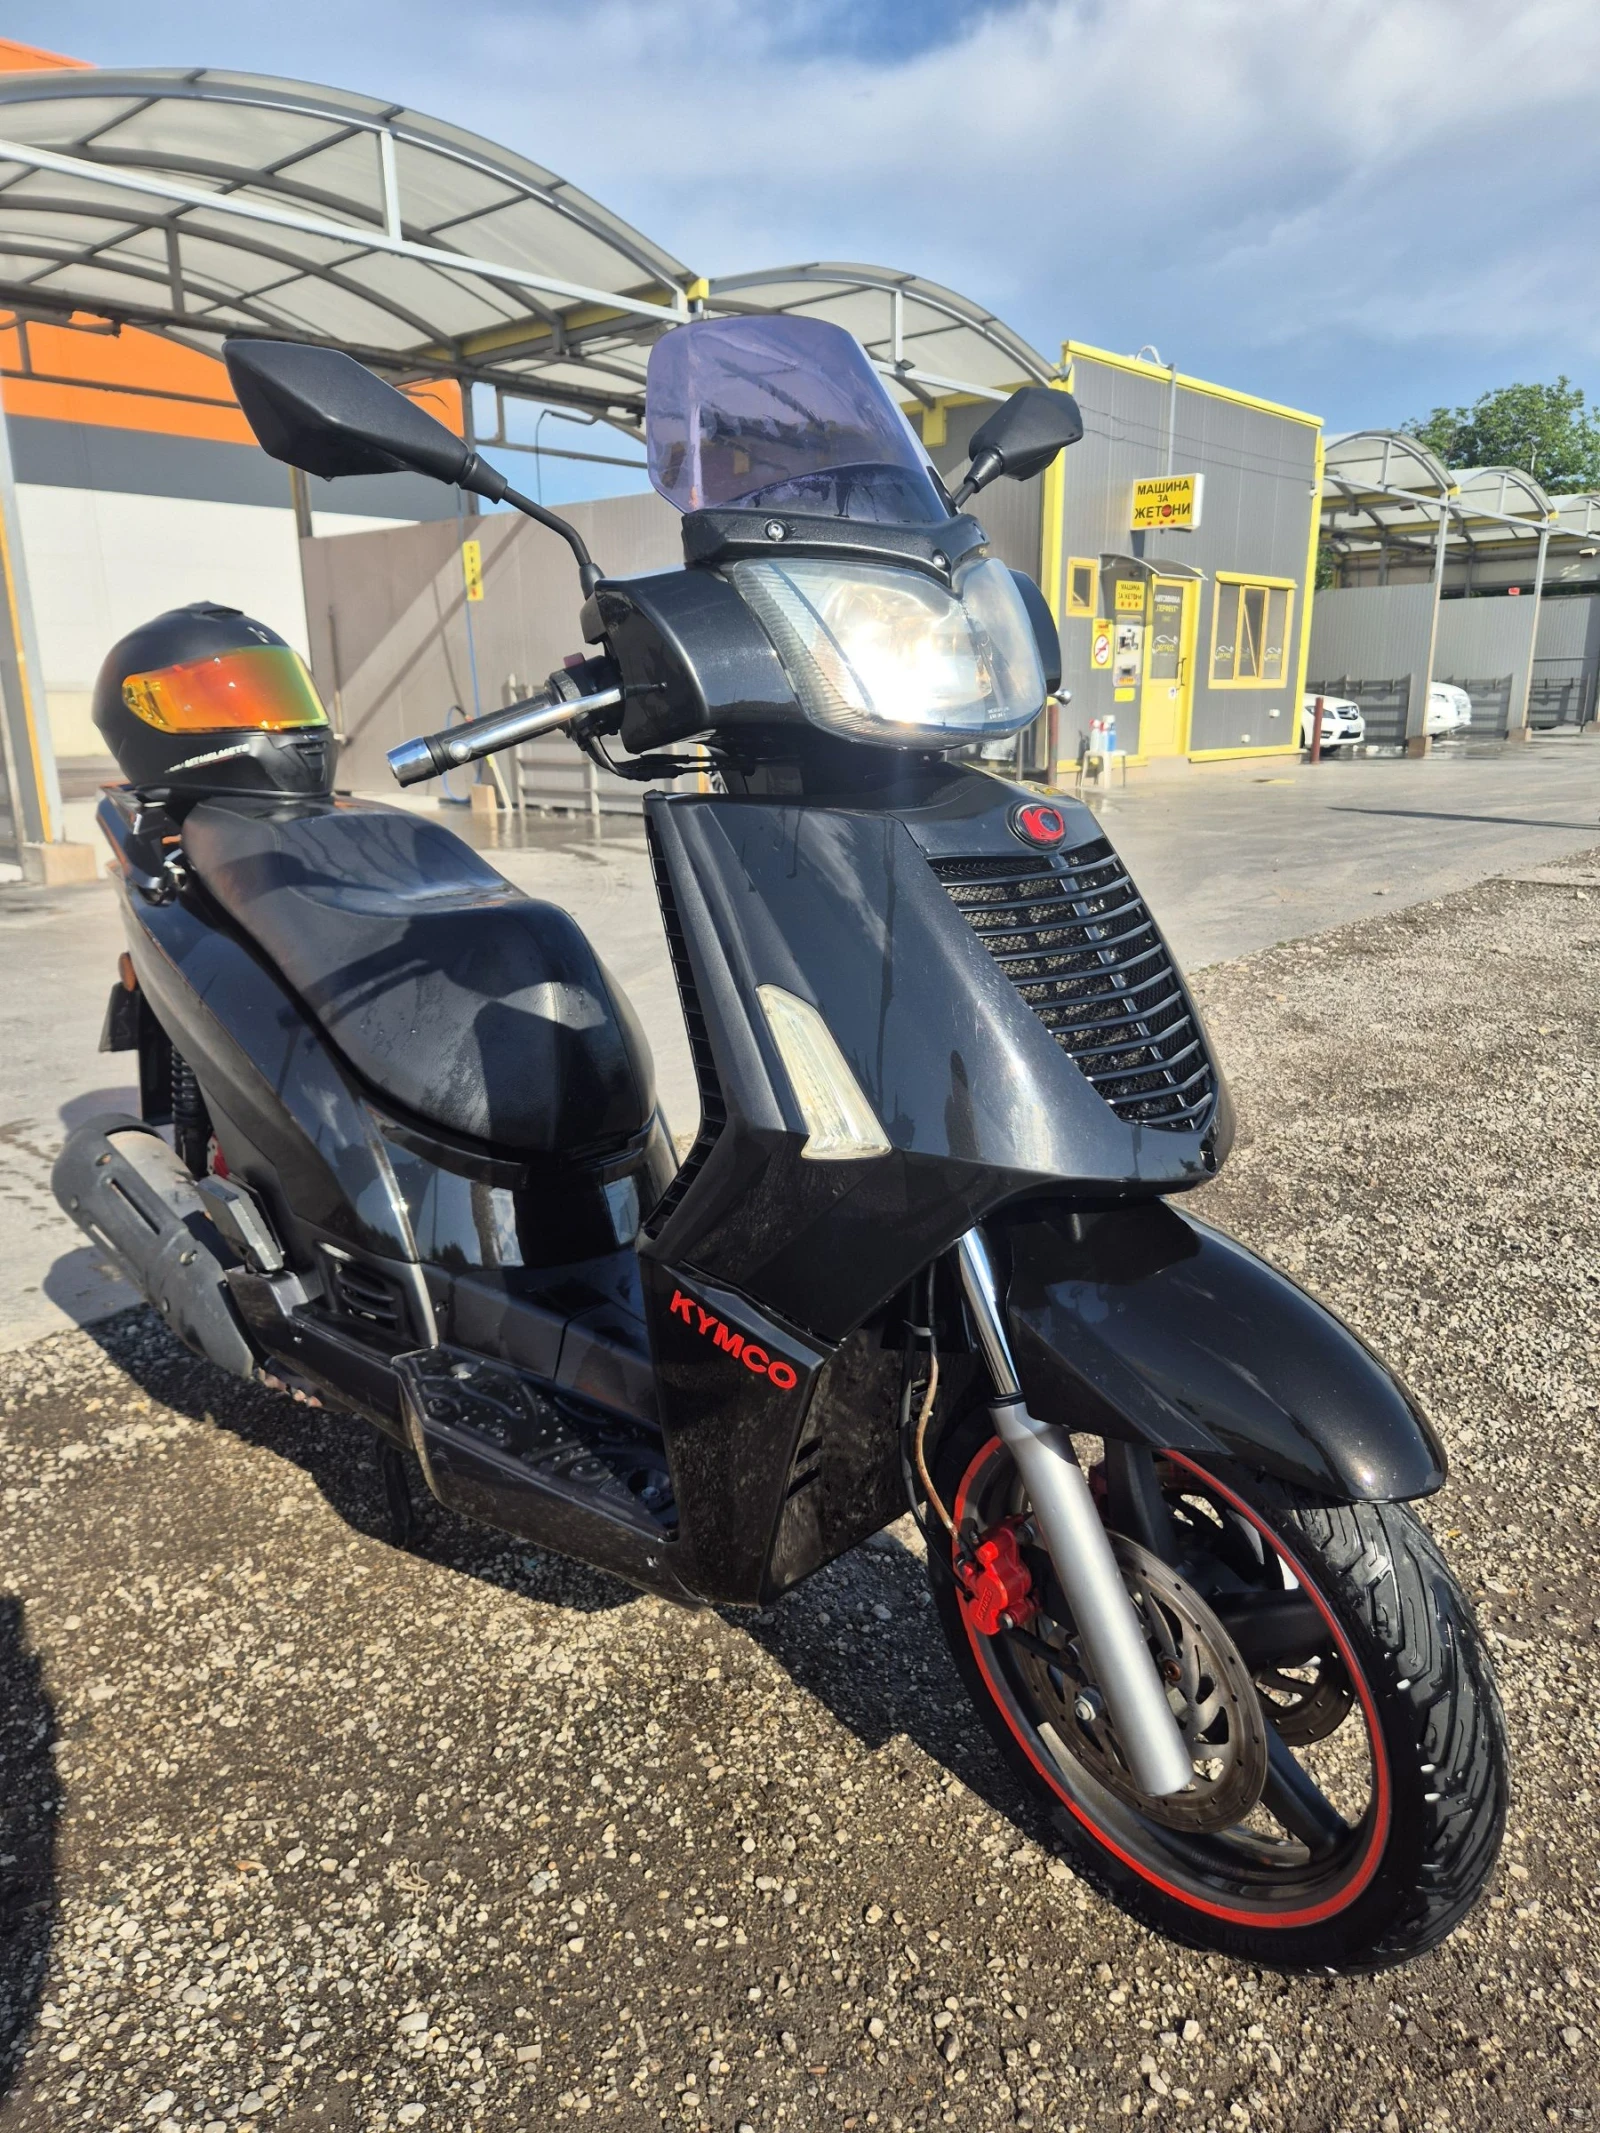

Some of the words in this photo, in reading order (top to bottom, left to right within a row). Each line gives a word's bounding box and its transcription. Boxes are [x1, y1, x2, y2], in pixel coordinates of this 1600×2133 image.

[1137, 480, 1190, 495] МАШИНА
[1157, 494, 1169, 503] ЗА
[669, 1289, 797, 1390] KYMCO
